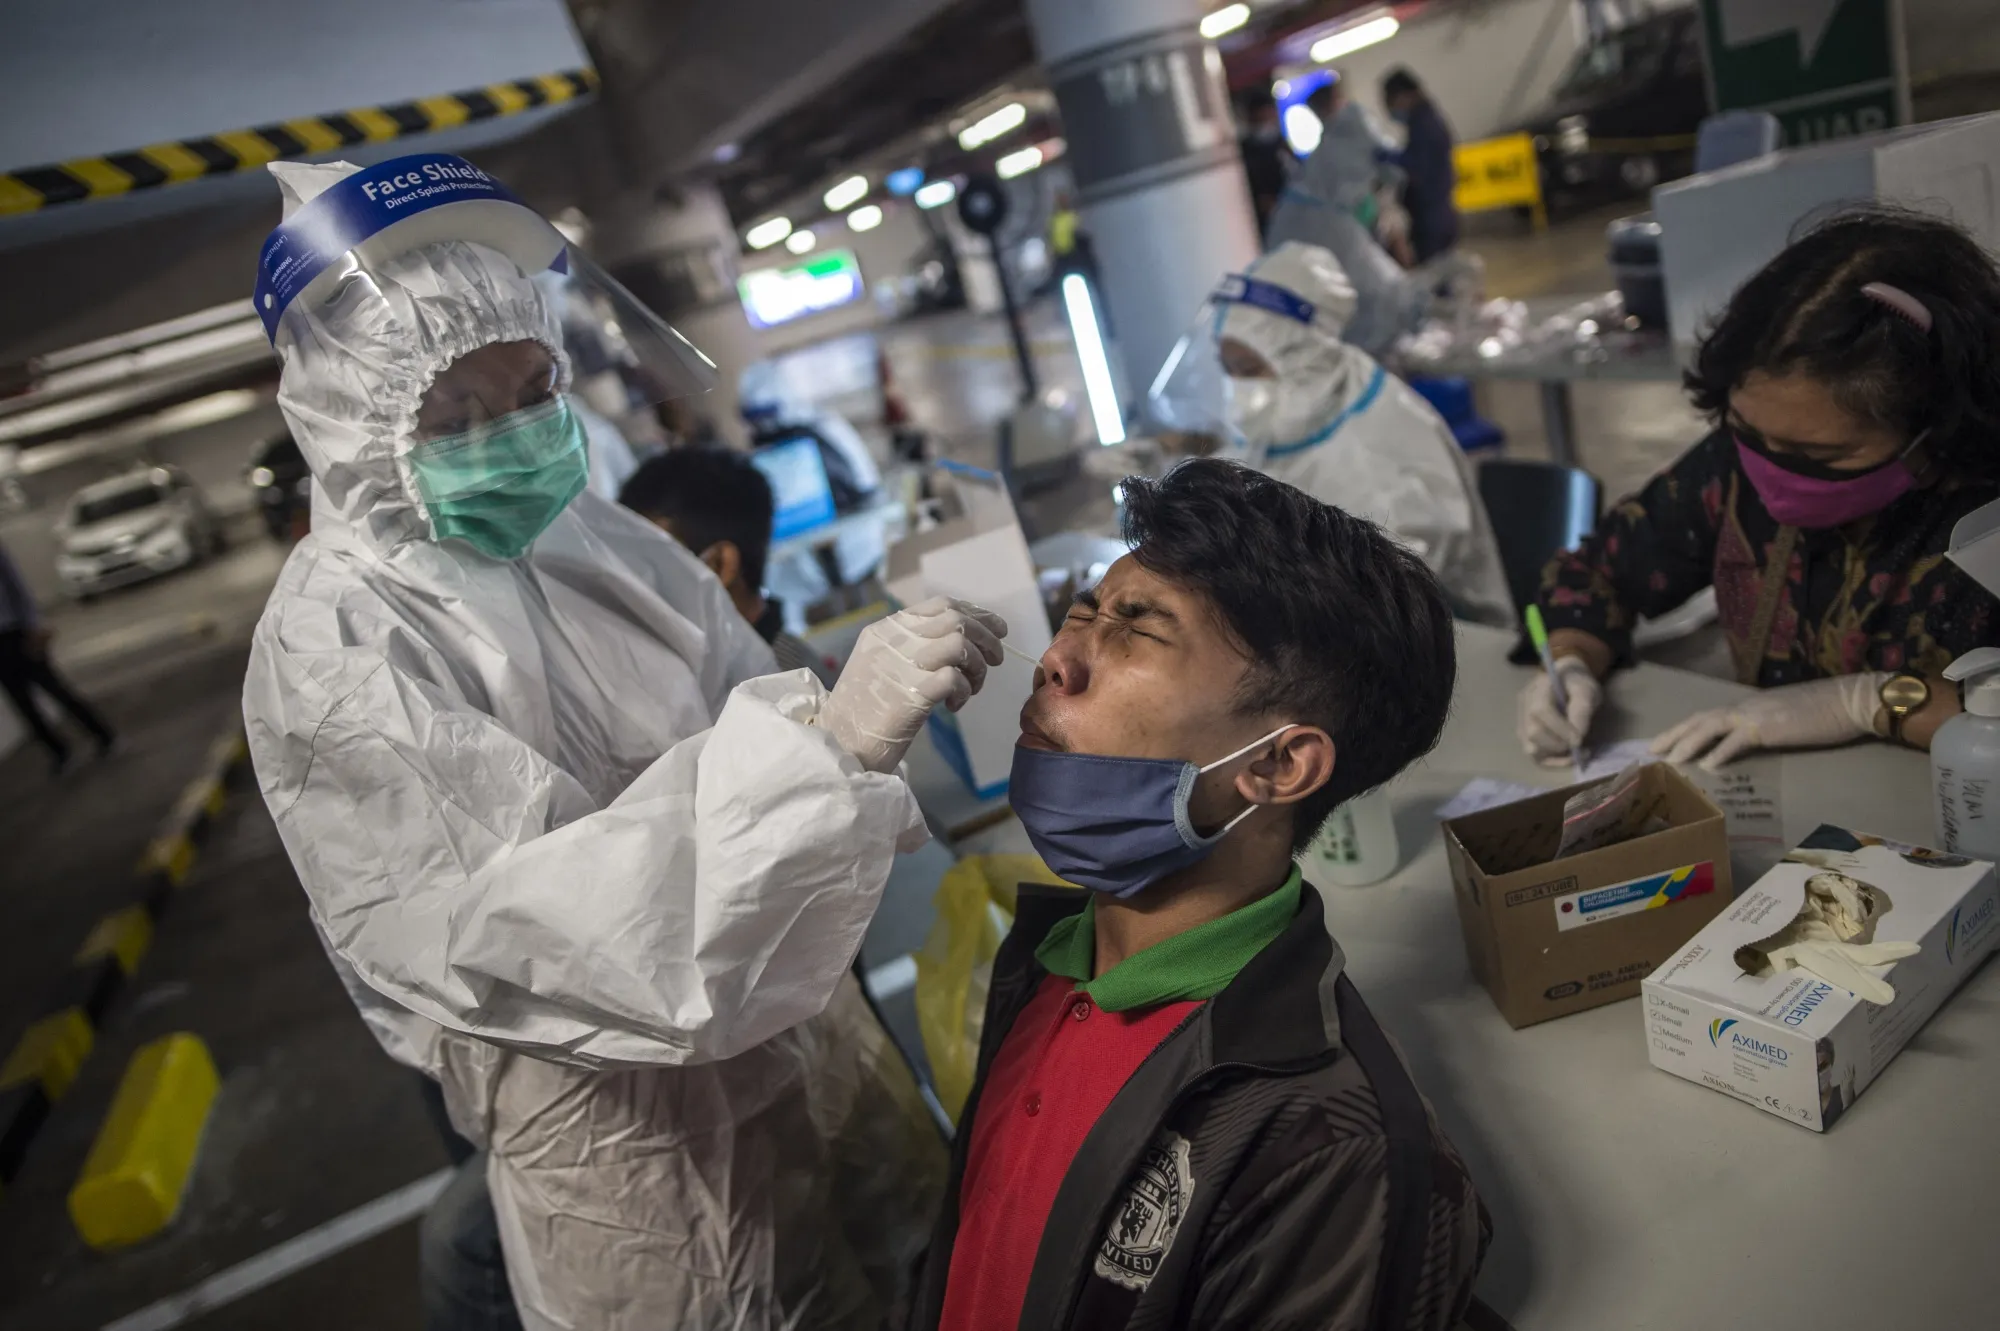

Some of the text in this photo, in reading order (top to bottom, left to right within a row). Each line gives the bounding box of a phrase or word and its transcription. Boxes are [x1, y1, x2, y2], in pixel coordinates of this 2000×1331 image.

[361, 162, 491, 201] Face Shield
[384, 181, 494, 209] Direct Splash Protection
[271, 255, 293, 283] WARNING
[1660, 999, 1690, 1015] X-Small
[1783, 982, 1833, 1026] AXIMED
[1661, 1014, 1682, 1027] Small
[1663, 1028, 1693, 1046] Medium
[1664, 1043, 1686, 1057] Large
[1732, 1033, 1788, 1061] AXIMED
[1702, 1075, 1736, 1092] AXION
[1146, 1151, 1179, 1219] CHESTER
[1101, 1240, 1152, 1271] NITED
